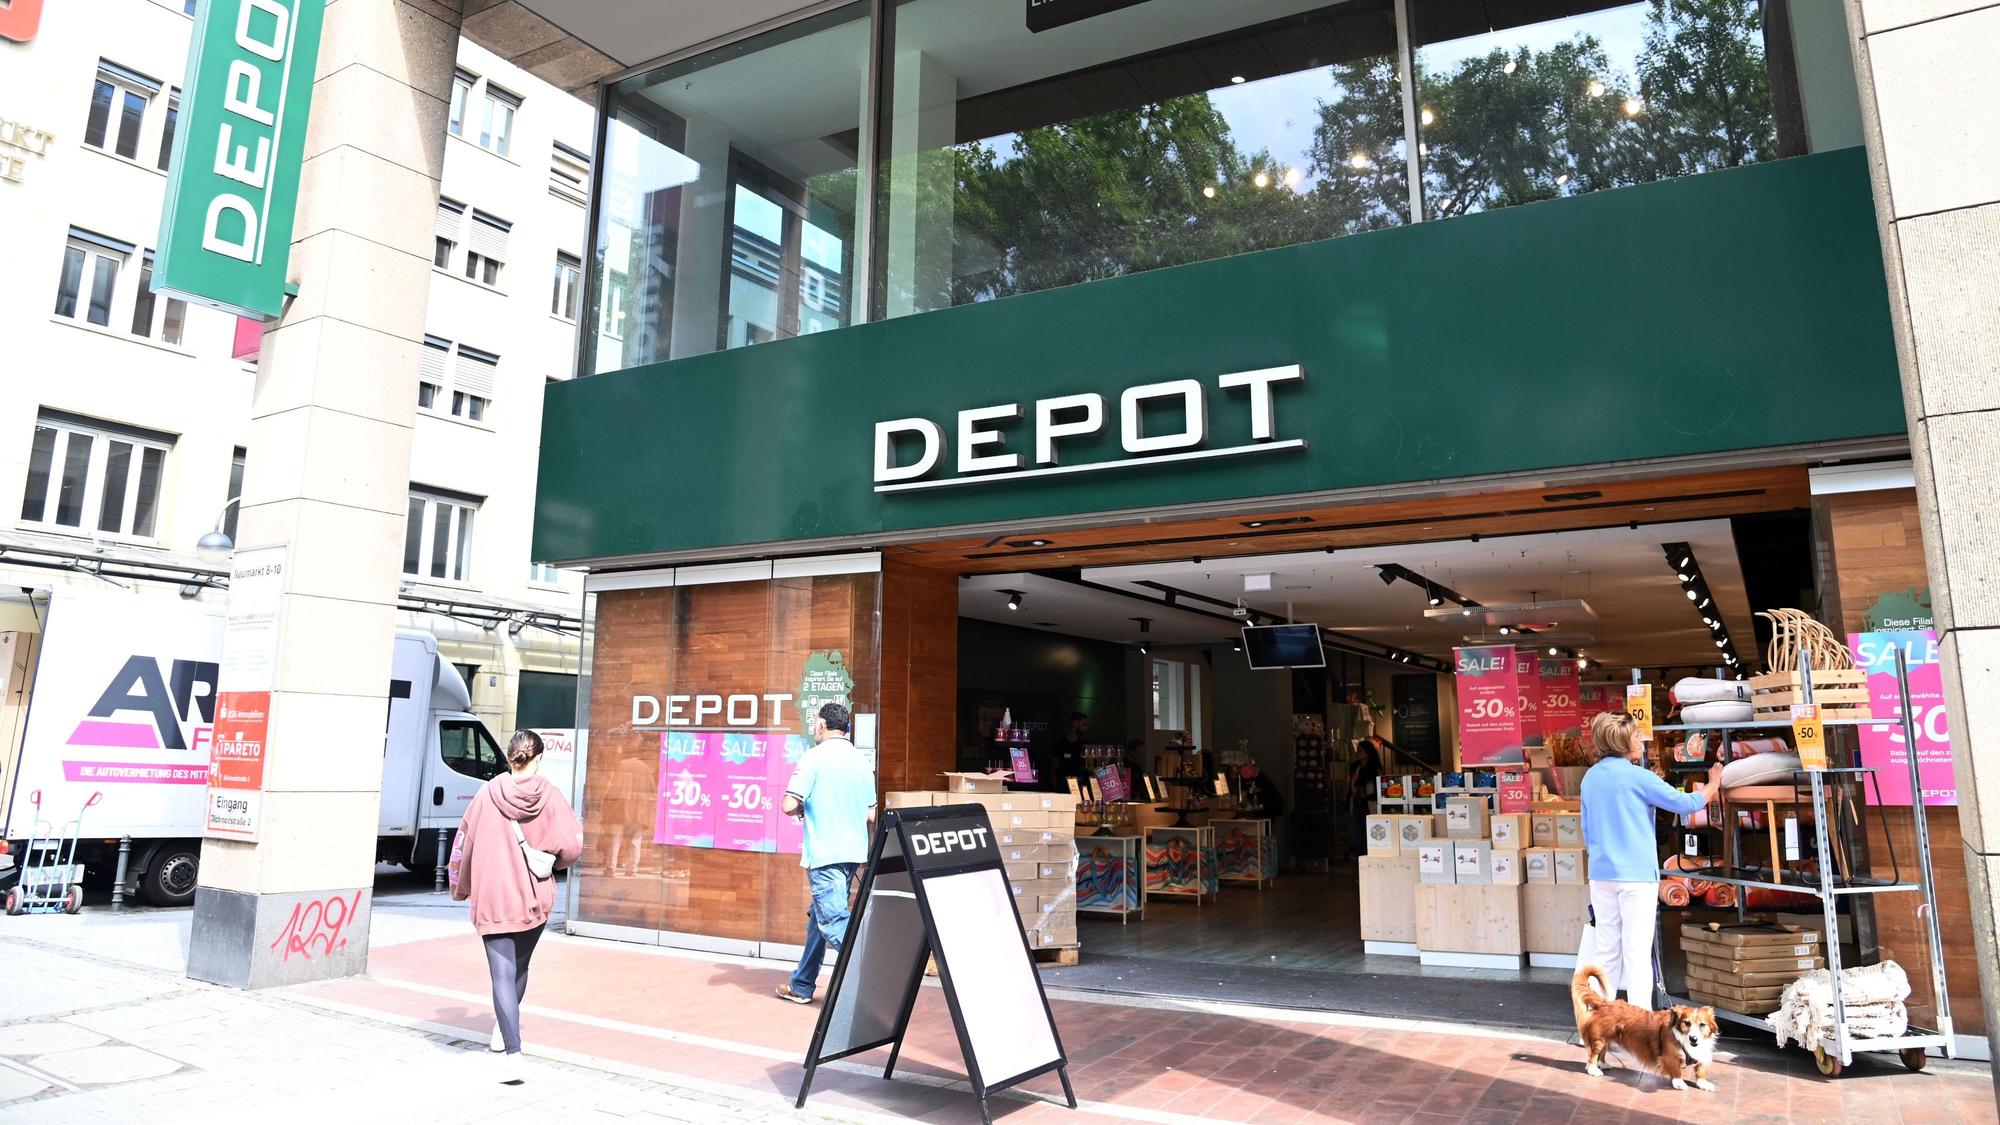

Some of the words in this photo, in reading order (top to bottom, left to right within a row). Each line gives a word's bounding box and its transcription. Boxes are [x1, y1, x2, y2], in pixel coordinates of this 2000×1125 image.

[874, 364, 1304, 483] DEPOT
[234, 567, 264, 580] Neumarkt
[266, 564, 282, 576] 8-10
[1884, 618, 1910, 626] Diese
[1457, 657, 1505, 672] SALE!
[1539, 666, 1571, 677] SALE!
[803, 683, 809, 691] 2
[811, 682, 845, 691] ETAGEN
[1464, 698, 1515, 719] -30%
[1542, 694, 1577, 708] -30%
[632, 693, 792, 726] DEPOT
[662, 740, 706, 756] SALE!
[720, 740, 767, 758] SALE!
[80, 766, 96, 777] DIE
[96, 767, 171, 778] AUTOVERMIETUNG
[173, 769, 189, 779] DES
[663, 781, 711, 807] -30%
[720, 783, 773, 810] -30%
[1921, 789, 1957, 797] EPOT
[216, 796, 248, 813] Eingang
[911, 828, 988, 856] DEPOT
[271, 890, 363, 963] 129!
